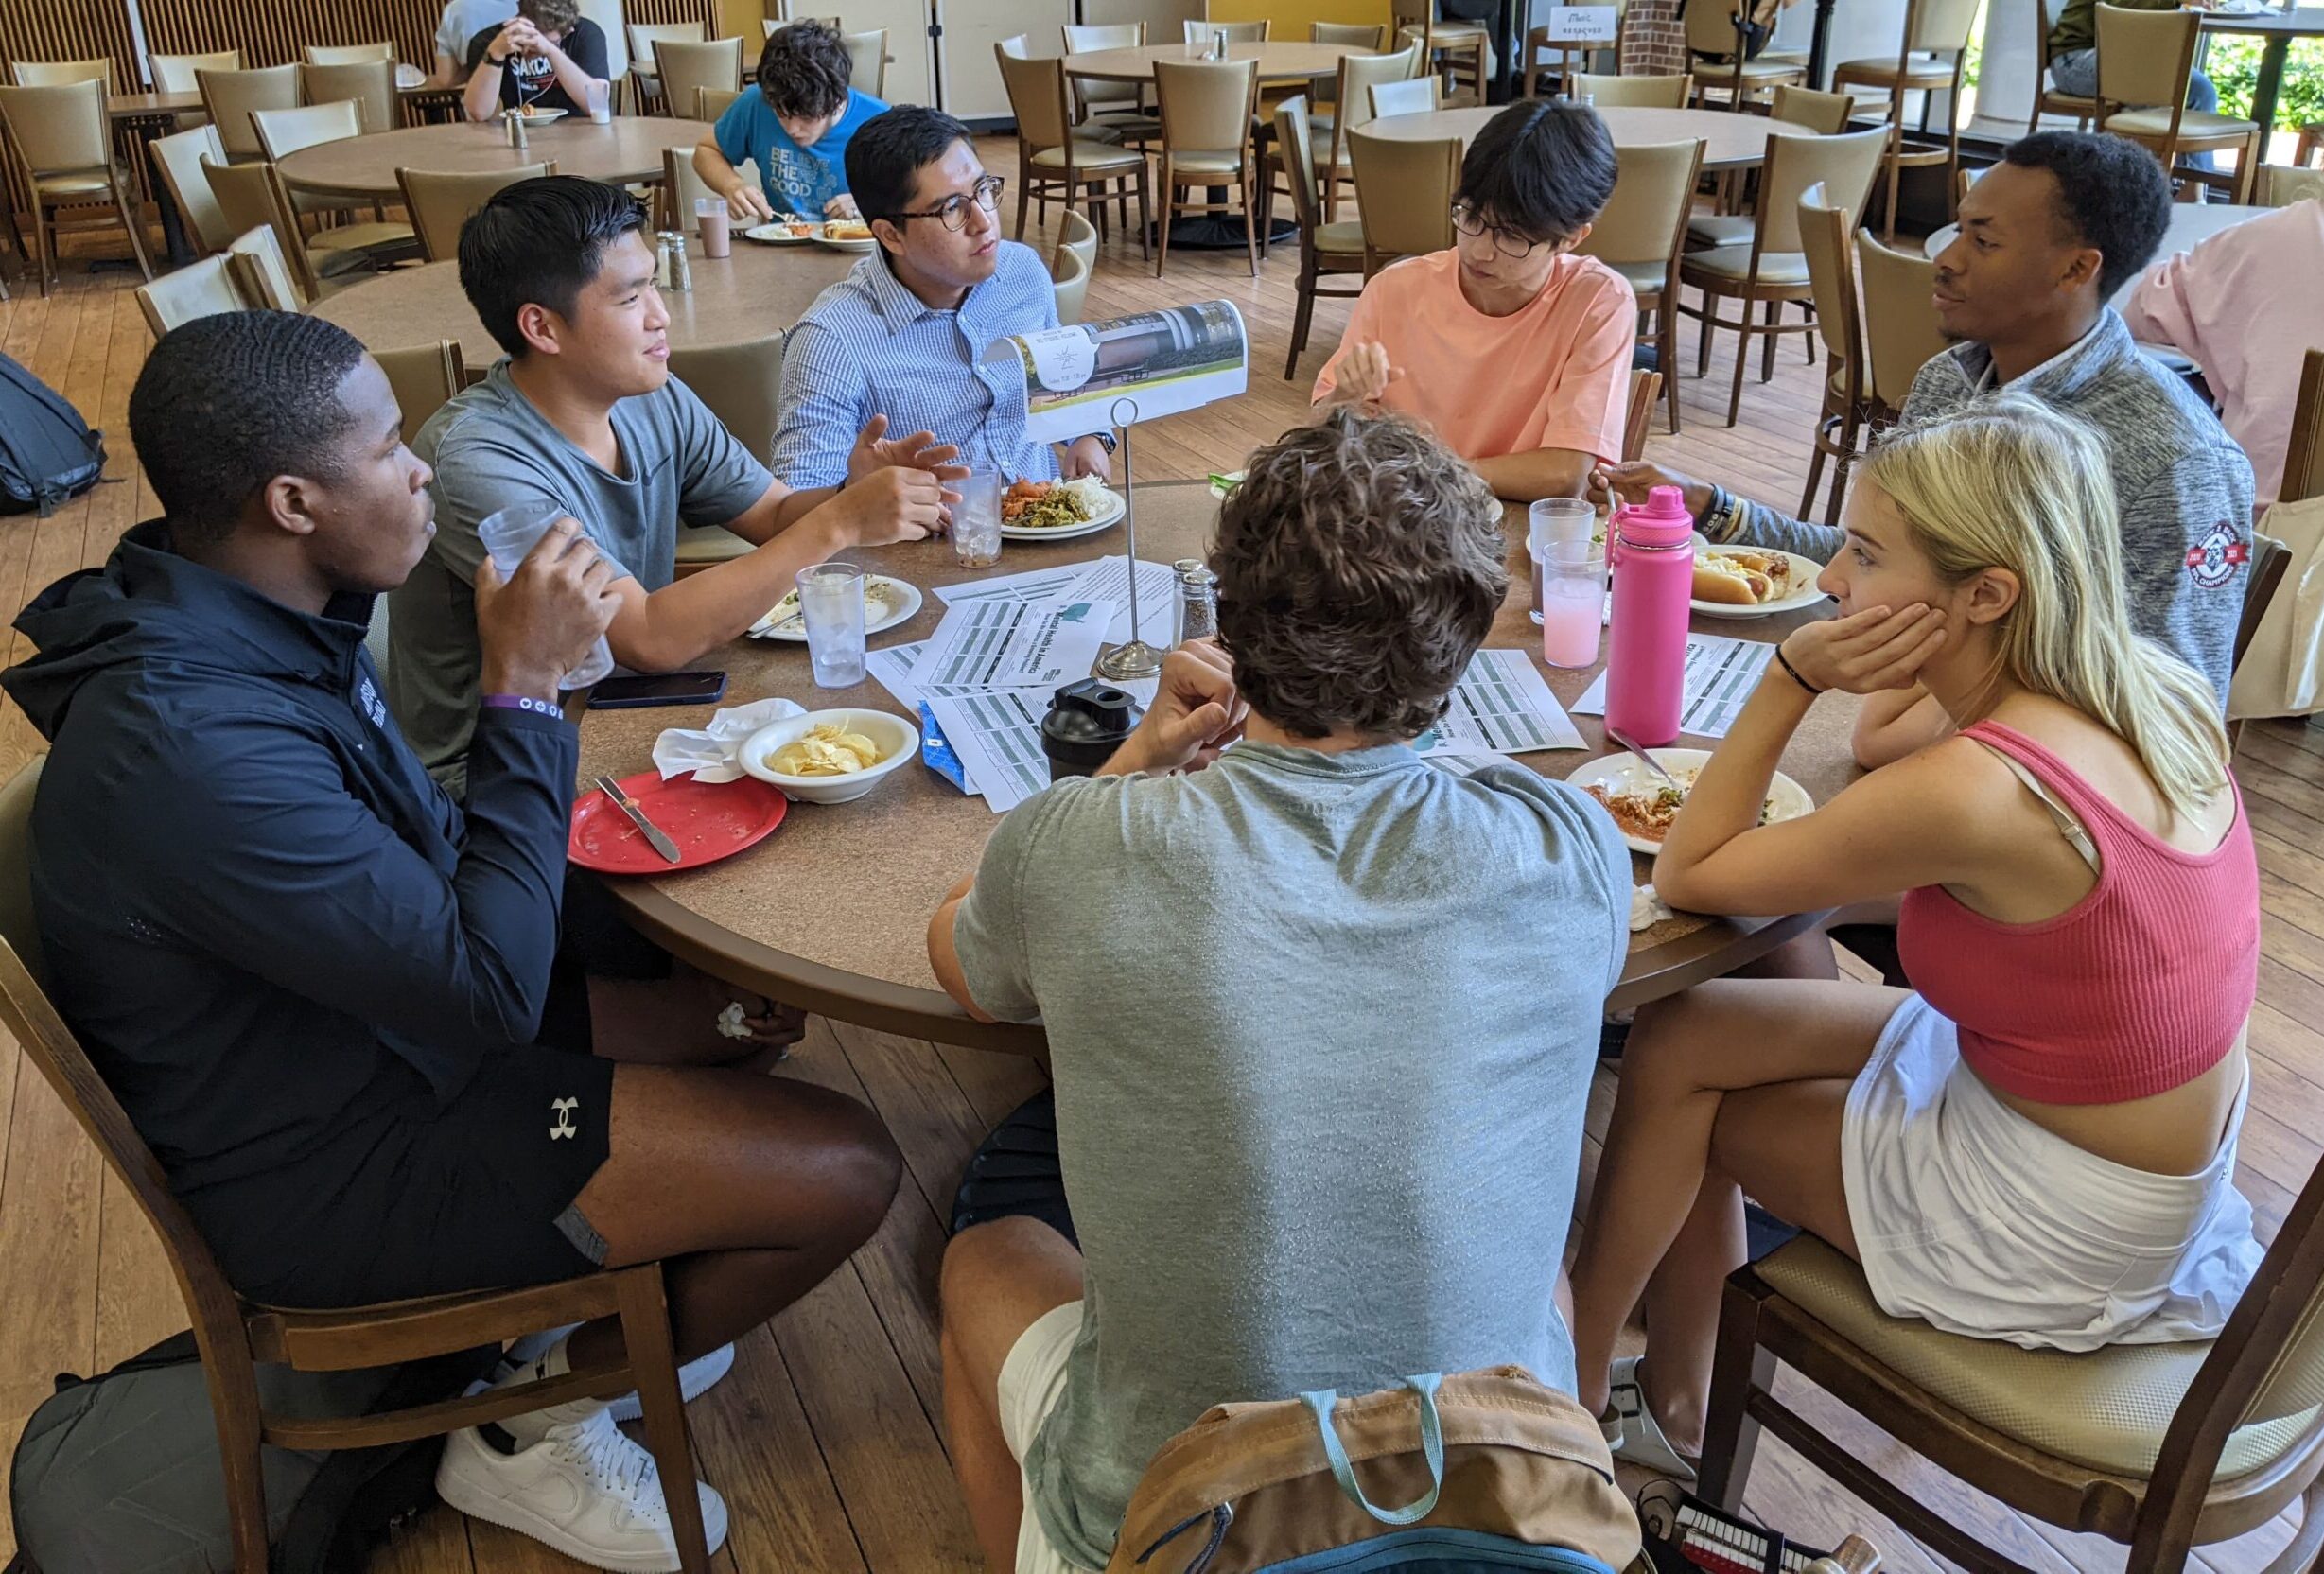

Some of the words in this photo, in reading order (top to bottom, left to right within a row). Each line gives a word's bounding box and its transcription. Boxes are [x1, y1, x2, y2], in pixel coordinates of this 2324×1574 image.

[510, 57, 553, 76] SARCA
[770, 176, 812, 197] GOOD
[1041, 630, 1057, 647] Health
[1027, 654, 1046, 673] America
